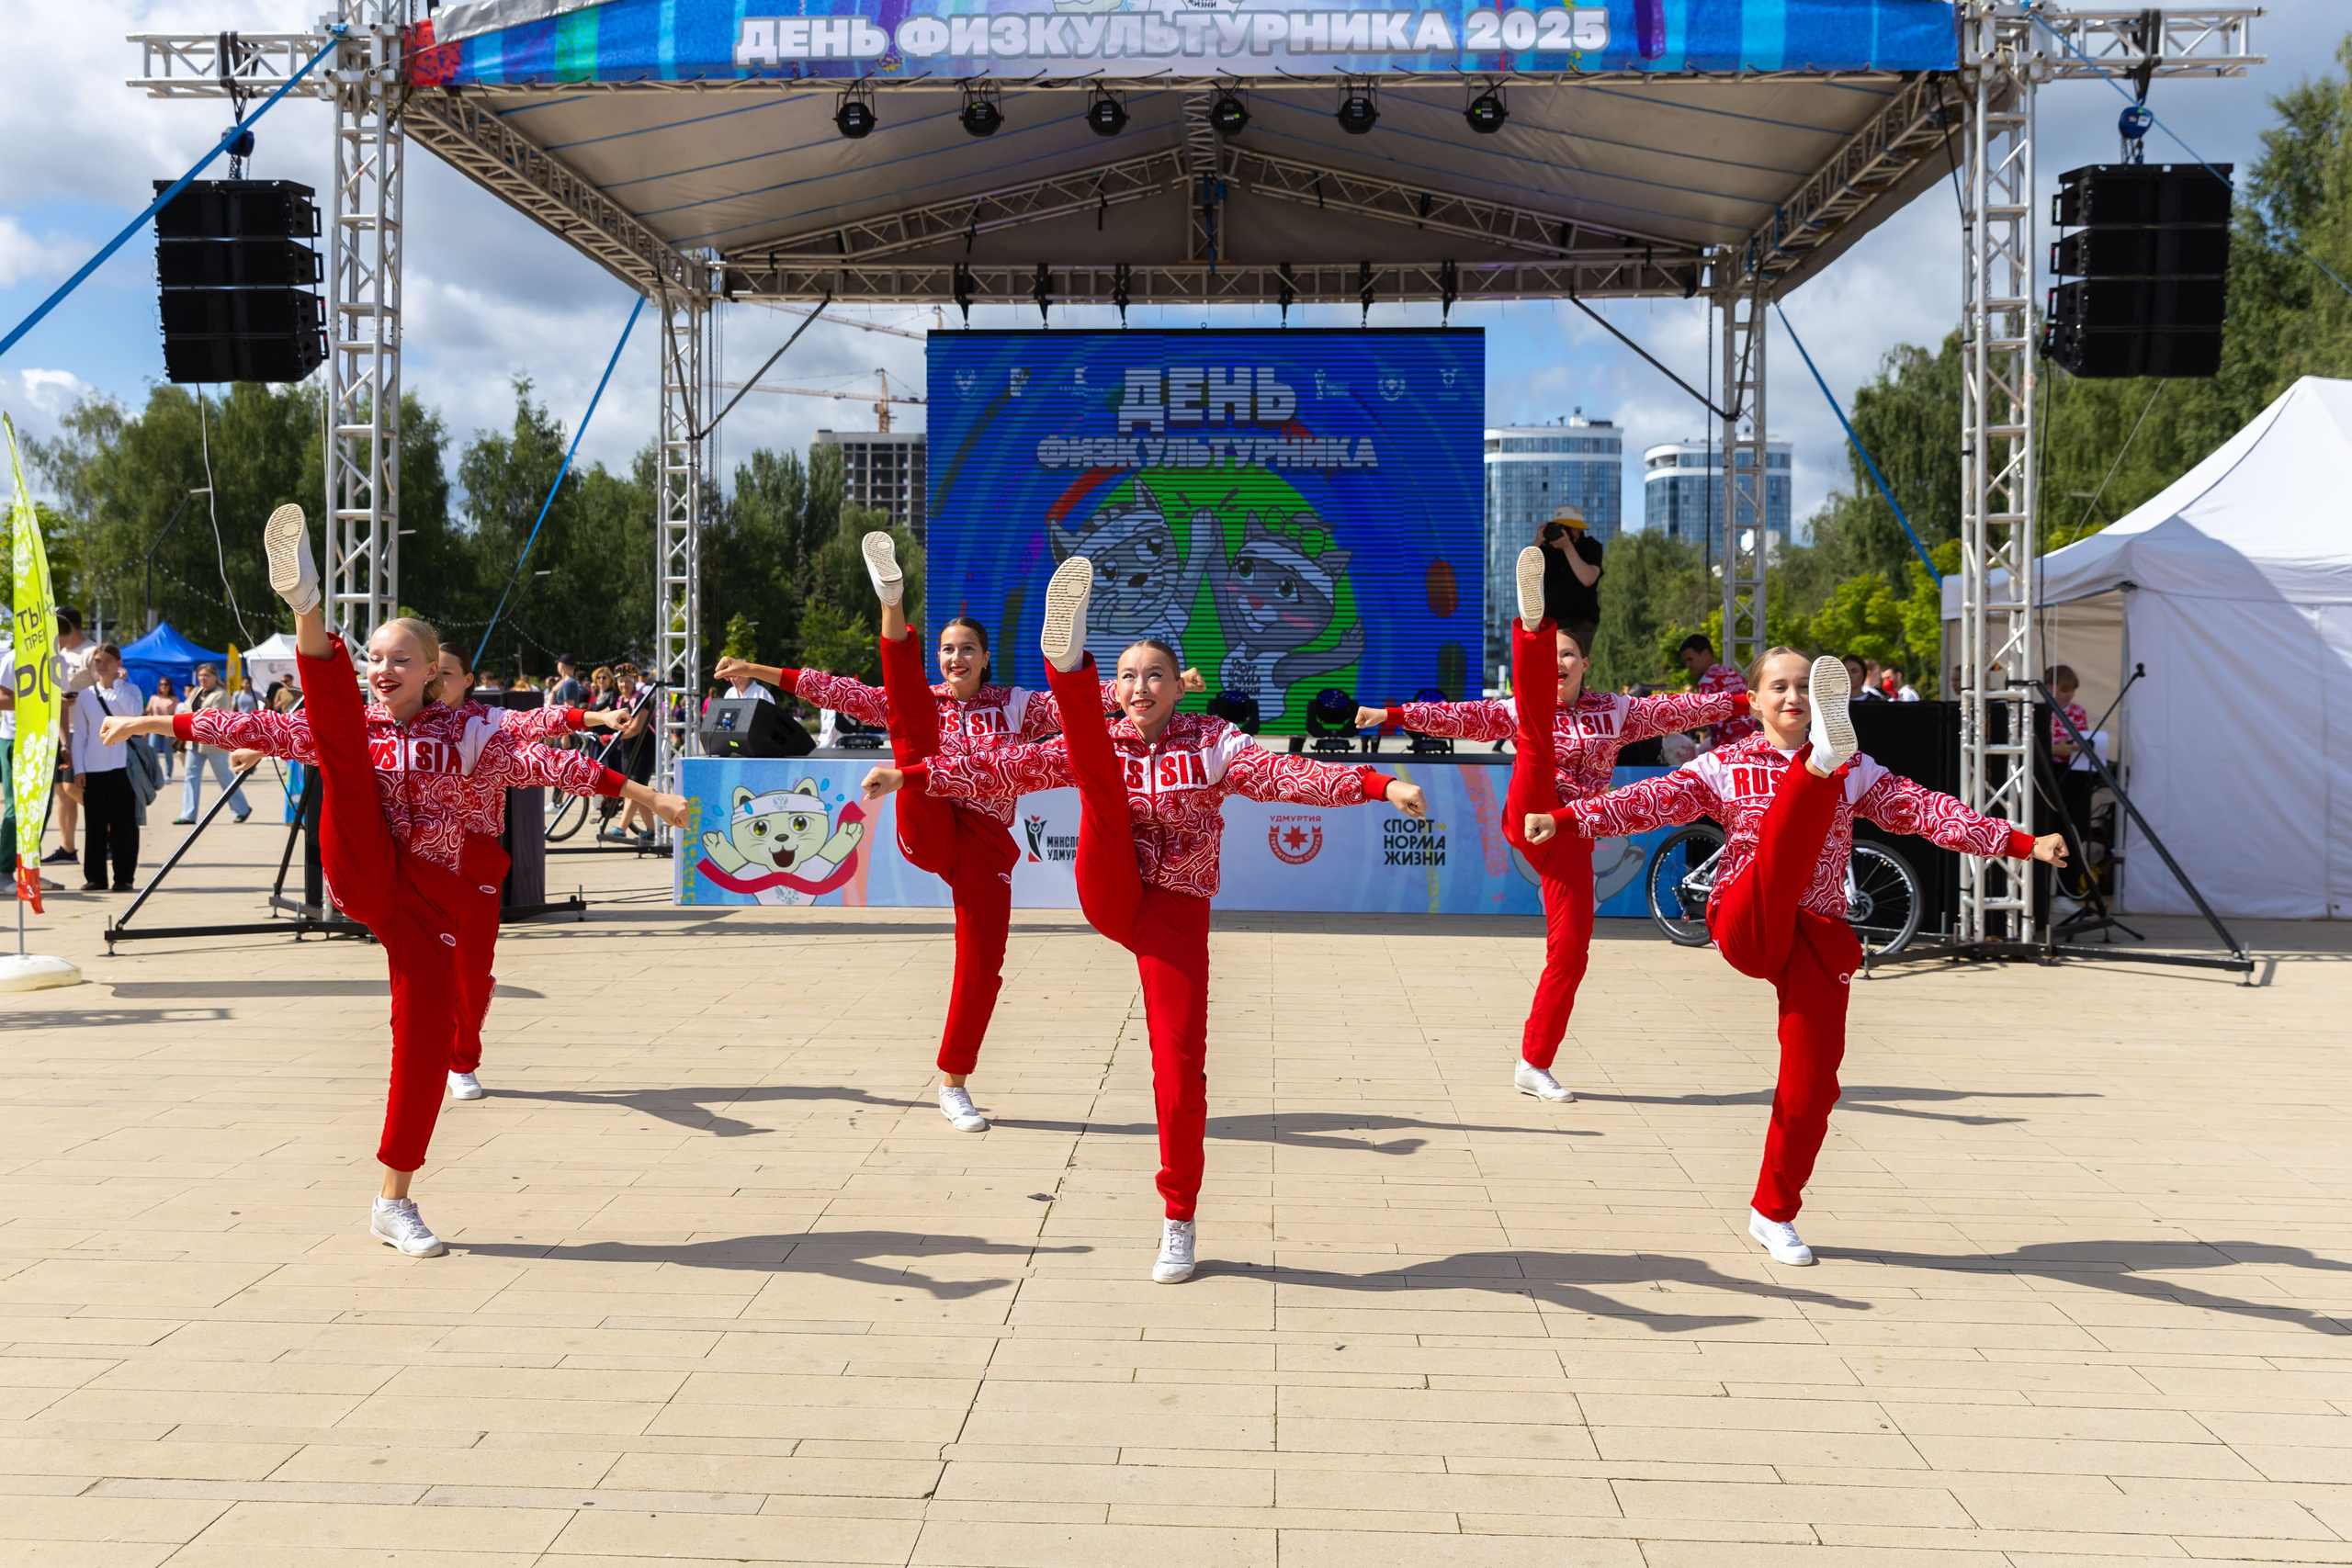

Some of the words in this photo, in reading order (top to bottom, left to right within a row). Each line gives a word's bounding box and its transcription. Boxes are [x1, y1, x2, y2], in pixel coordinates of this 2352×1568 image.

[736, 18, 886, 65] ДЕНЬ
[898, 11, 1454, 57] ФИЗКУЛЬТУРНИКА
[1466, 10, 1607, 50] 2025
[1118, 367, 1296, 432] ДЕНЬ
[1036, 434, 1379, 468] ФИЗКУЛЬТУРНИКА
[16, 601, 42, 634] ТЫ
[1384, 818, 1434, 833] СПОРТ
[1047, 850, 1077, 861] УДМУР
[1270, 836, 1304, 863] ТЕРРИТОРИЯ
[1304, 836, 1321, 860] СПОРТА
[1384, 835, 1445, 850] НОРМА
[1384, 851, 1445, 865] ЖИЗНИ
